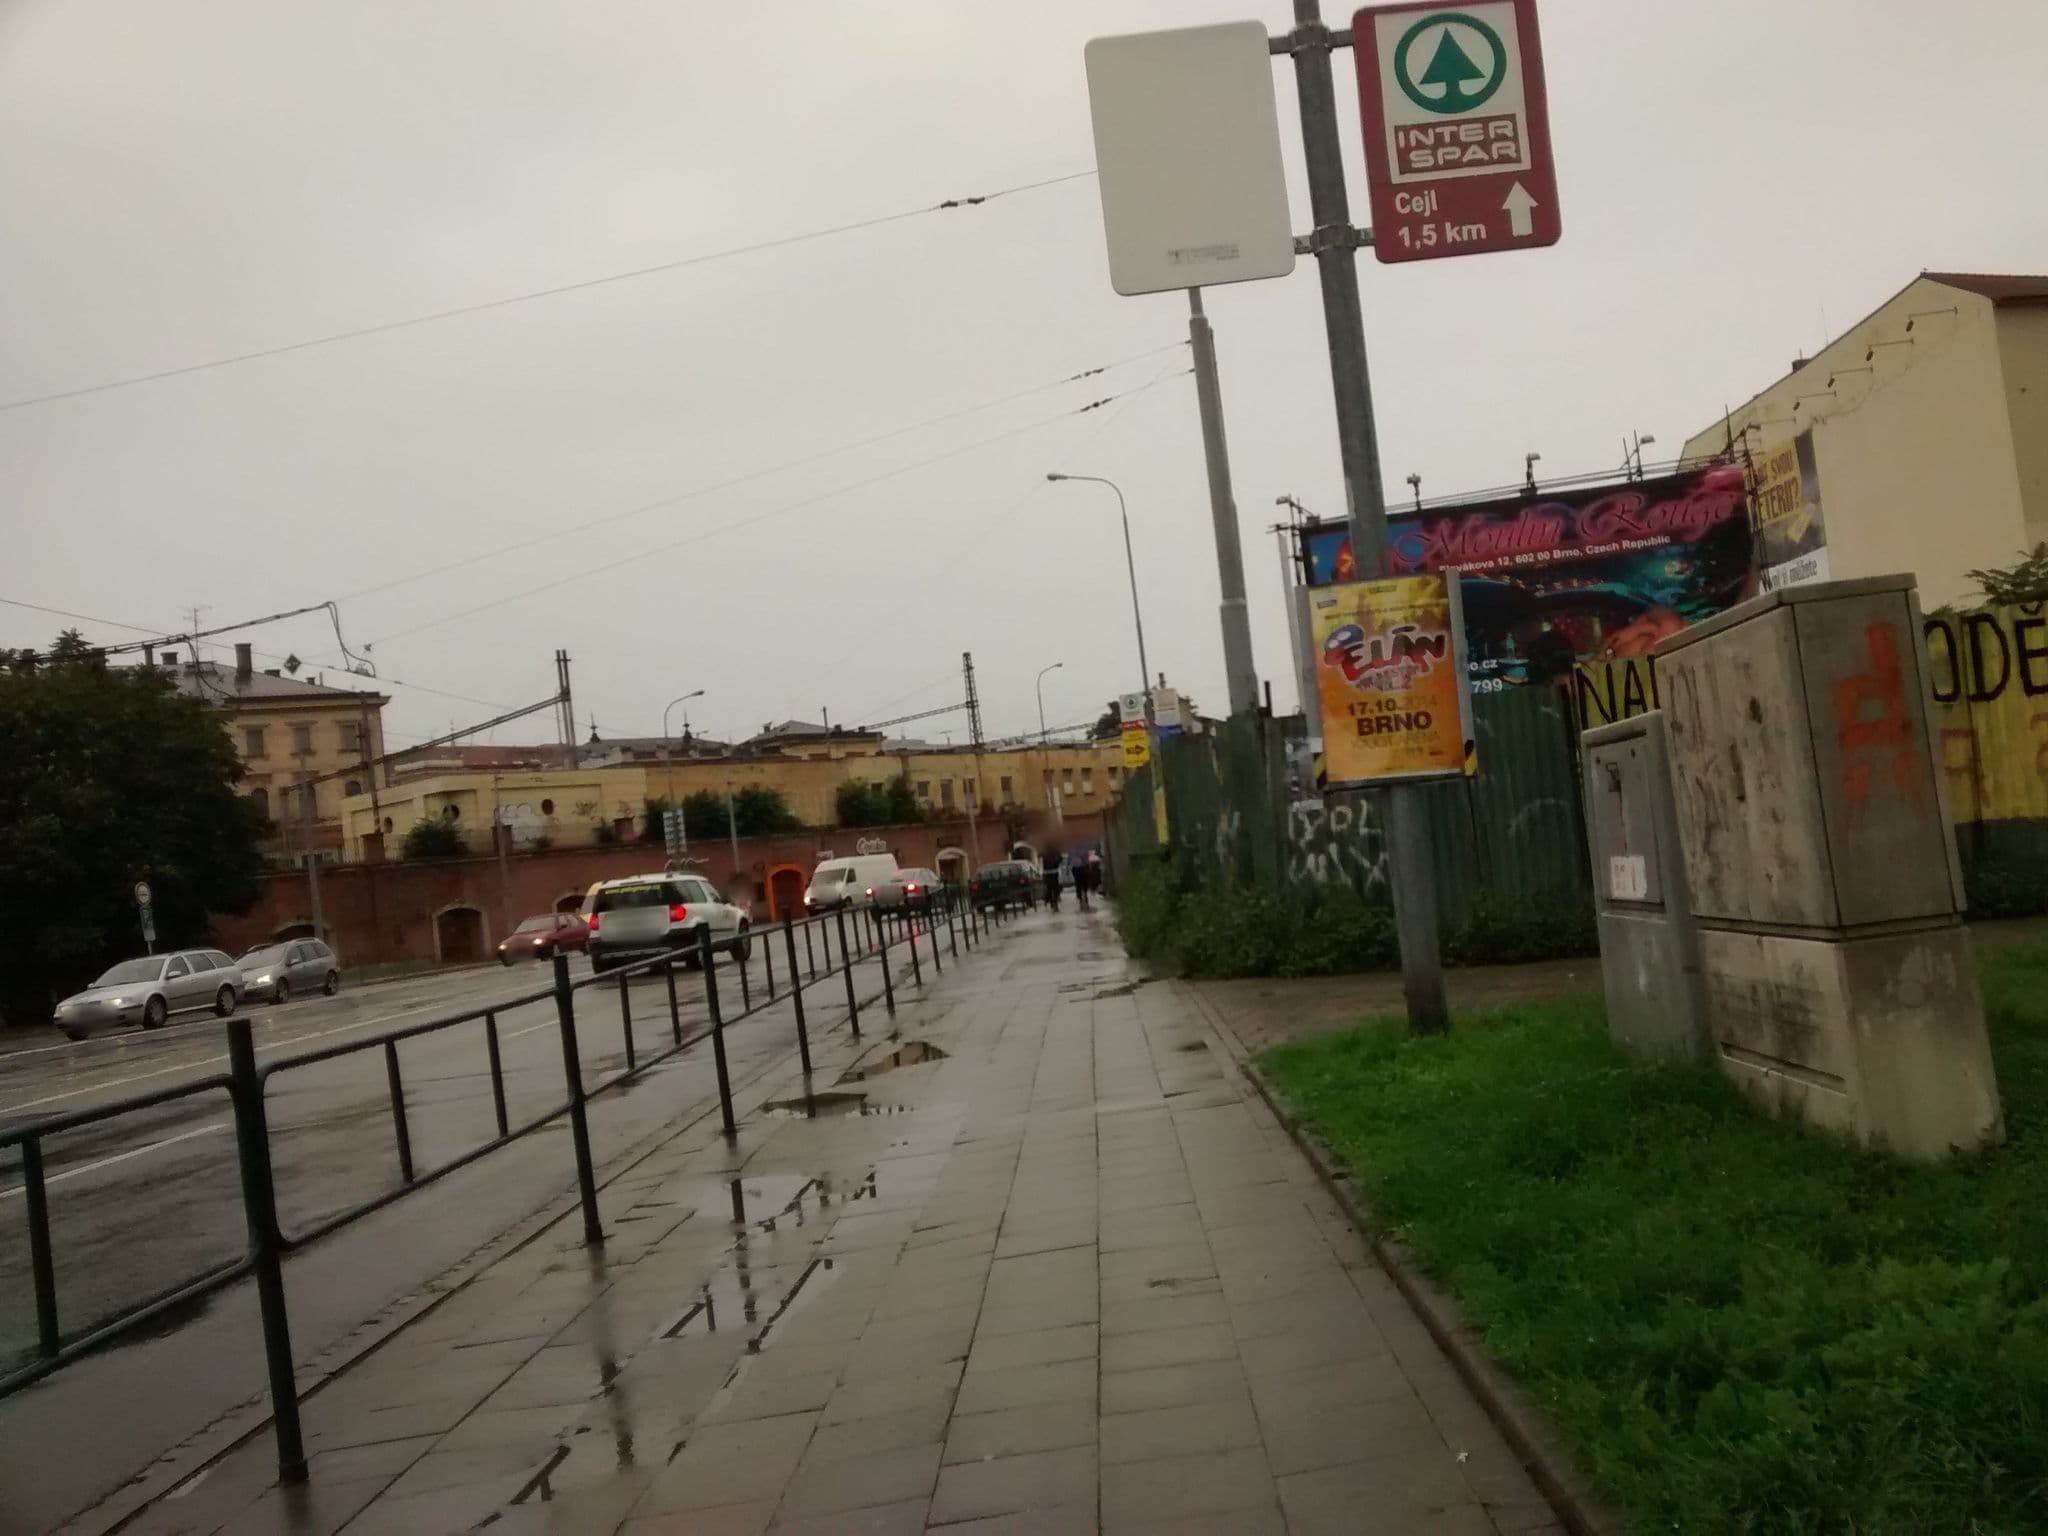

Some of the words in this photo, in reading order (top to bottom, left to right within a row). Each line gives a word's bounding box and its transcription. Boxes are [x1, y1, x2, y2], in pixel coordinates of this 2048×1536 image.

[1398, 120, 1514, 148] INTER
[1409, 141, 1517, 168] SPAR
[1395, 189, 1438, 217] Cejl
[1398, 223, 1438, 250] 1,5
[1445, 221, 1487, 243] km
[1515, 553, 1534, 565] 602
[1537, 551, 1551, 562] 00
[1553, 548, 1583, 560] Brno,
[1586, 541, 1620, 555] Czech
[1622, 534, 1672, 551] Republic
[1471, 678, 1503, 693] 799
[1356, 711, 1433, 736] BRNO
